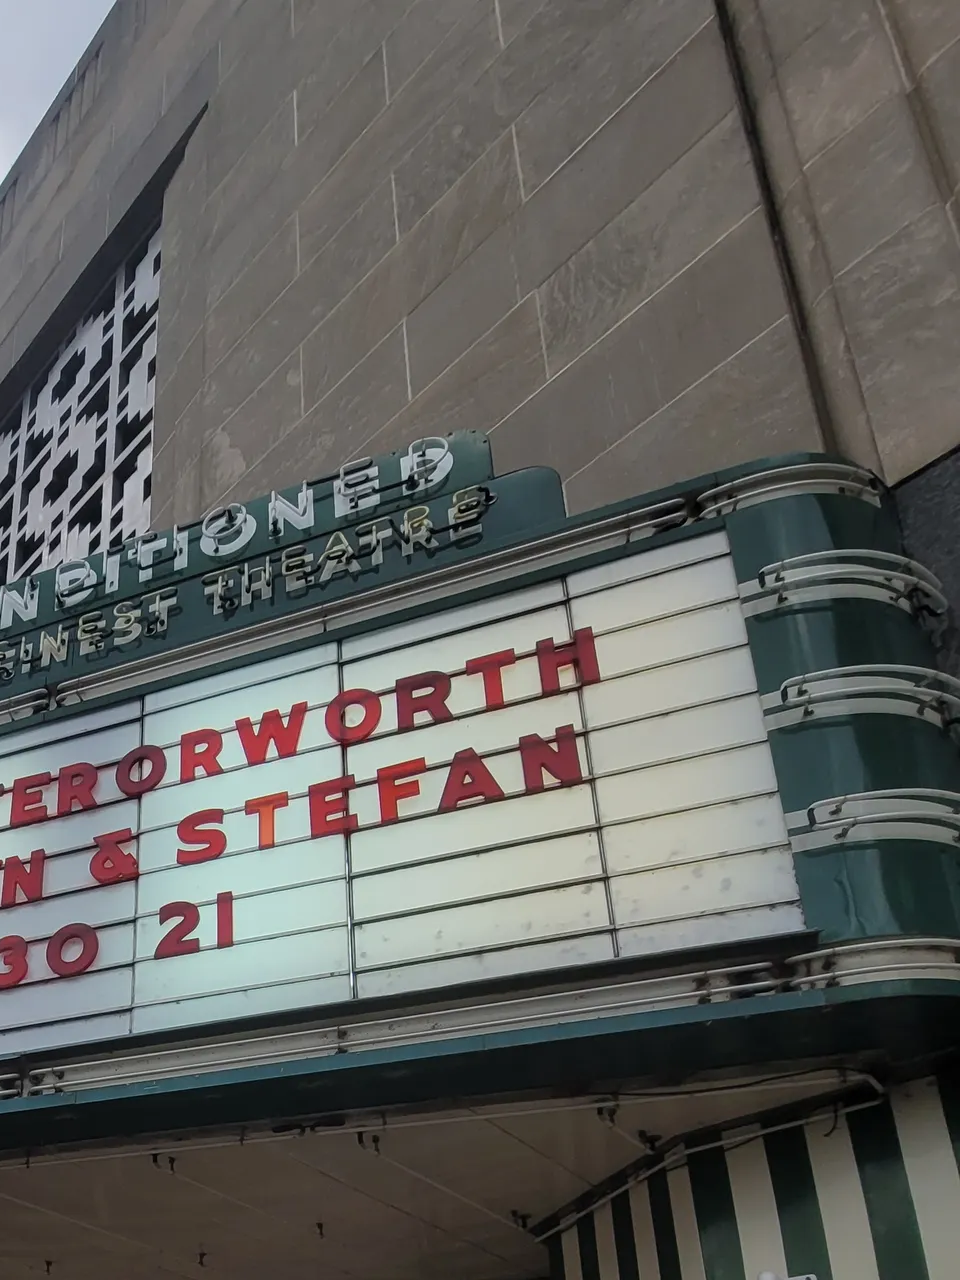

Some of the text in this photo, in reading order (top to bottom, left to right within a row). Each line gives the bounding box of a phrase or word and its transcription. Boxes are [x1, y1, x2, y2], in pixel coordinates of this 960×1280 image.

[201, 485, 497, 615] THEATRE
[89, 828, 139, 884] &
[176, 724, 584, 866] STEFAN
[153, 891, 234, 960] 21
